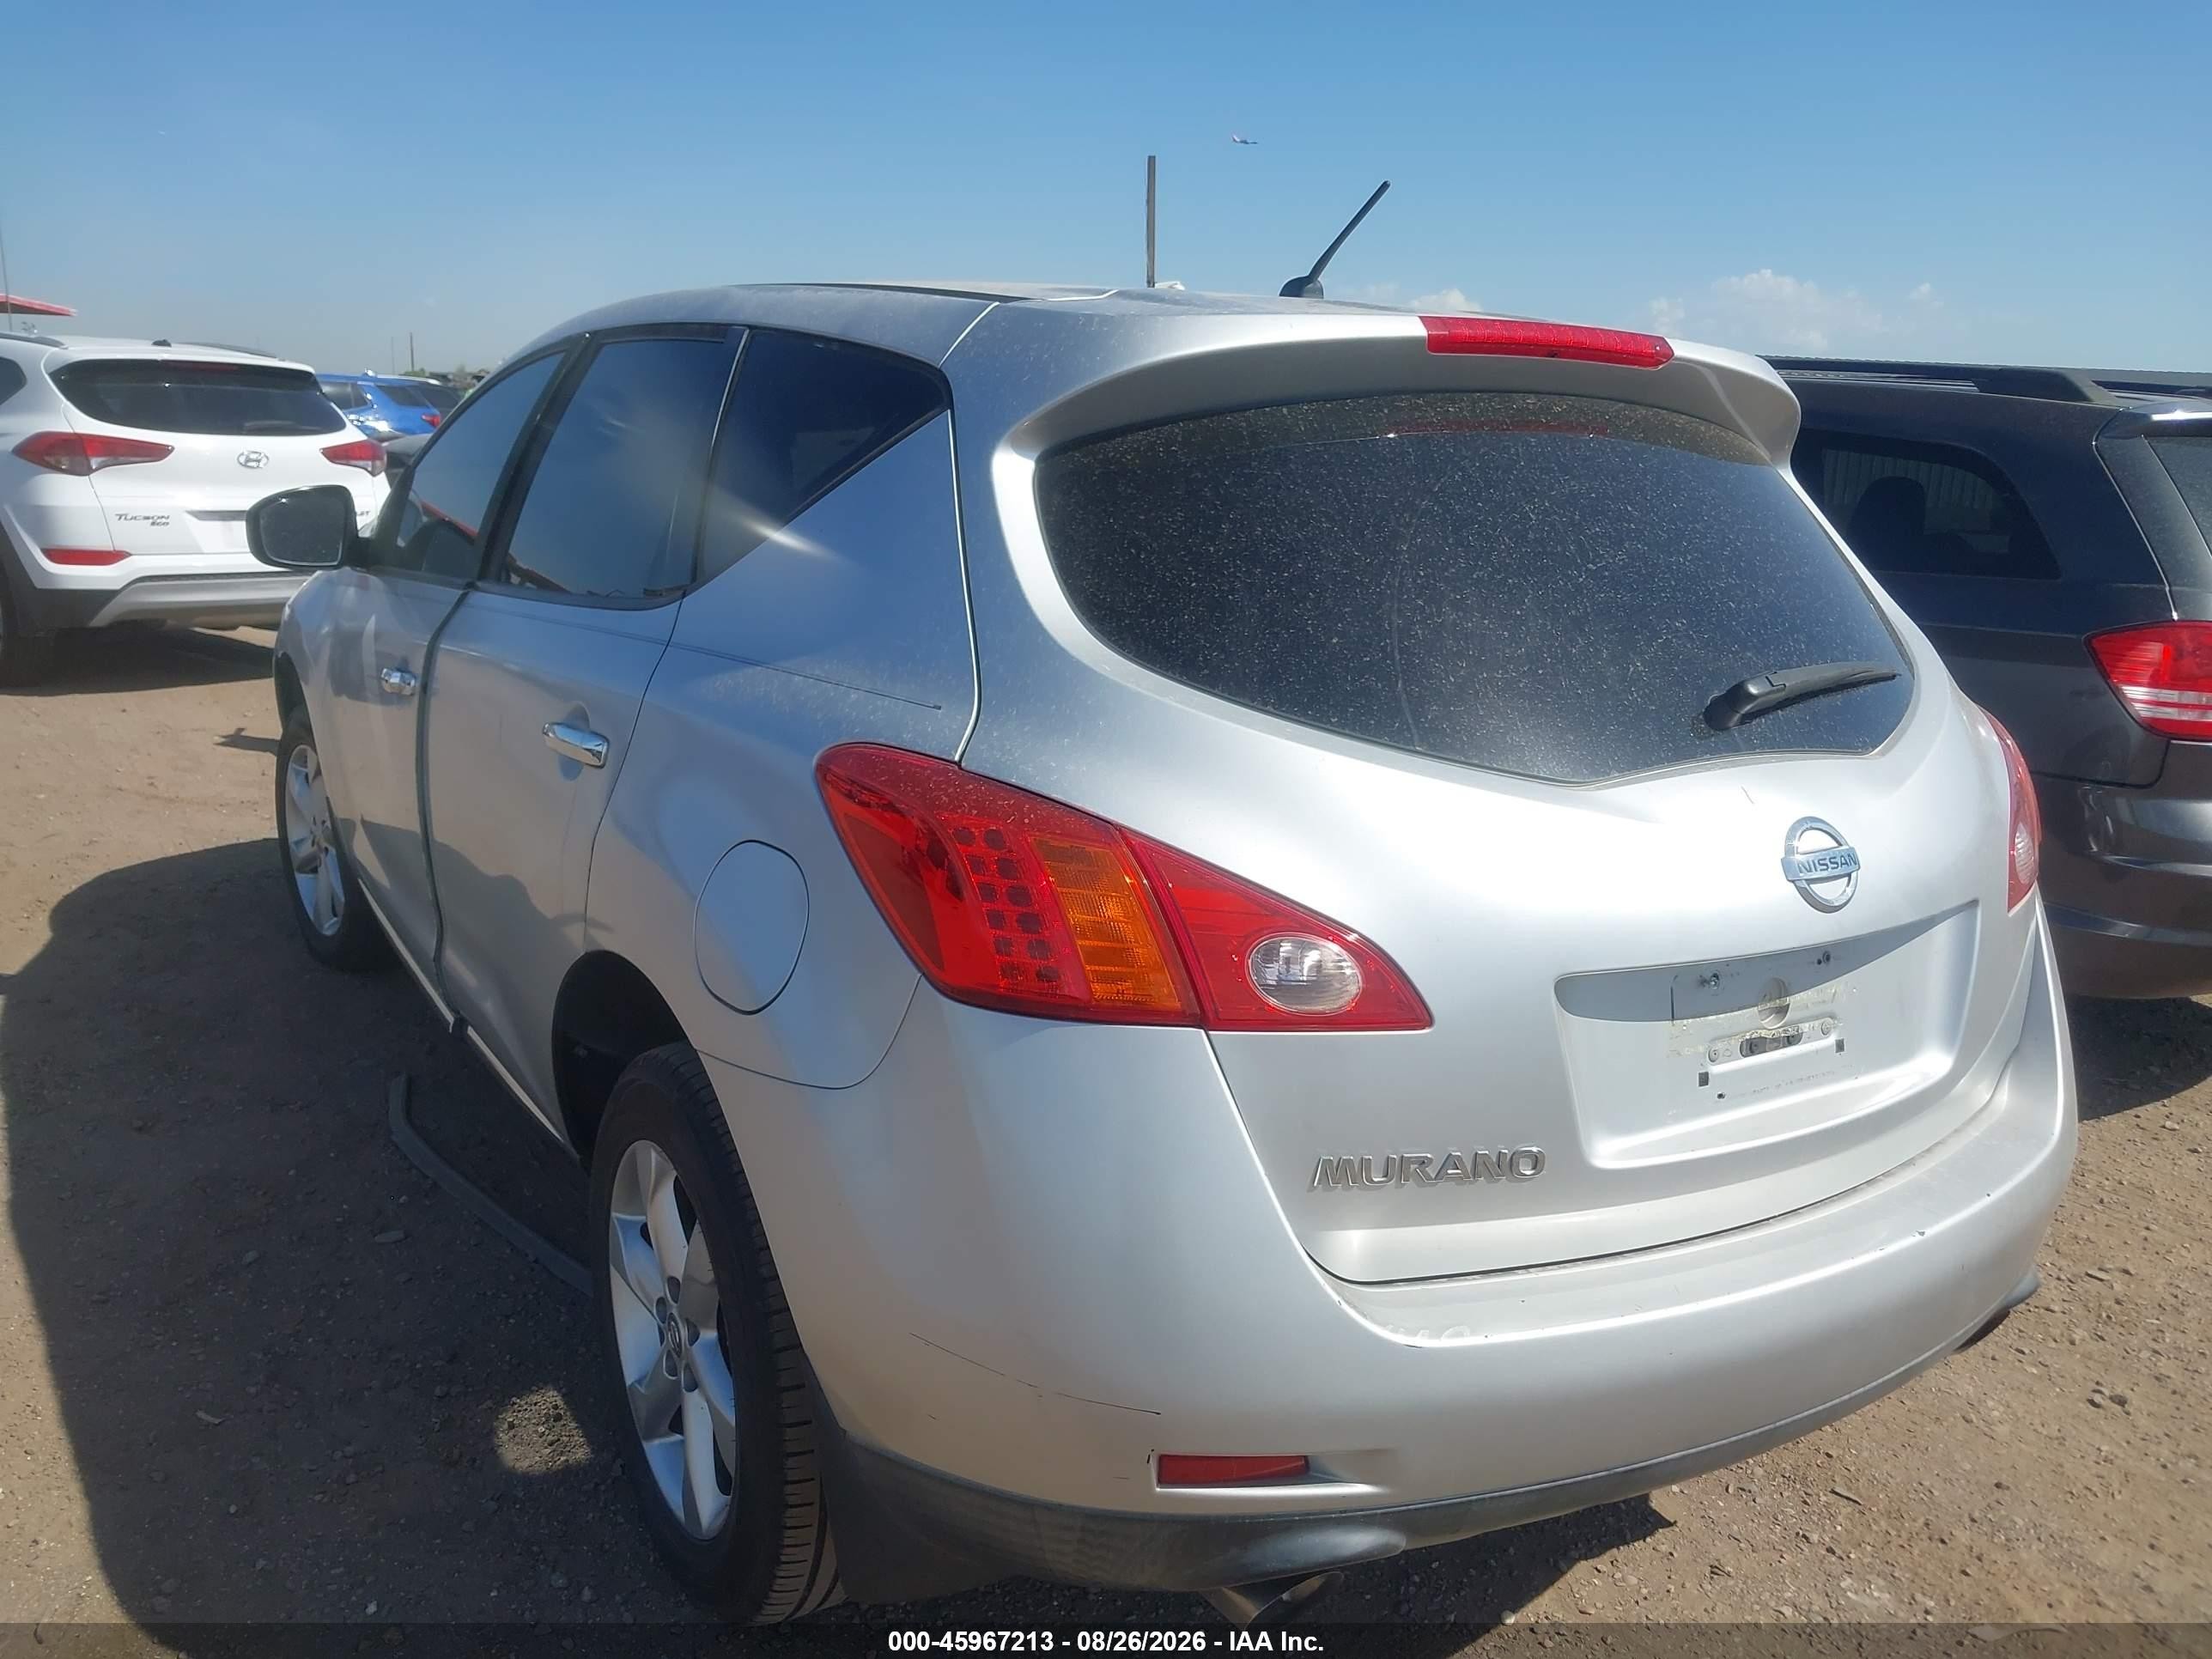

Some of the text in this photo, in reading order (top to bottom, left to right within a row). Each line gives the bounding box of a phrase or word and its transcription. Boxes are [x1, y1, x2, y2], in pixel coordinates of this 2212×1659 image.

[115, 513, 170, 521] TUCSON
[1797, 853, 1857, 874] NISSAN
[1312, 1146, 1546, 1187] MURANO
